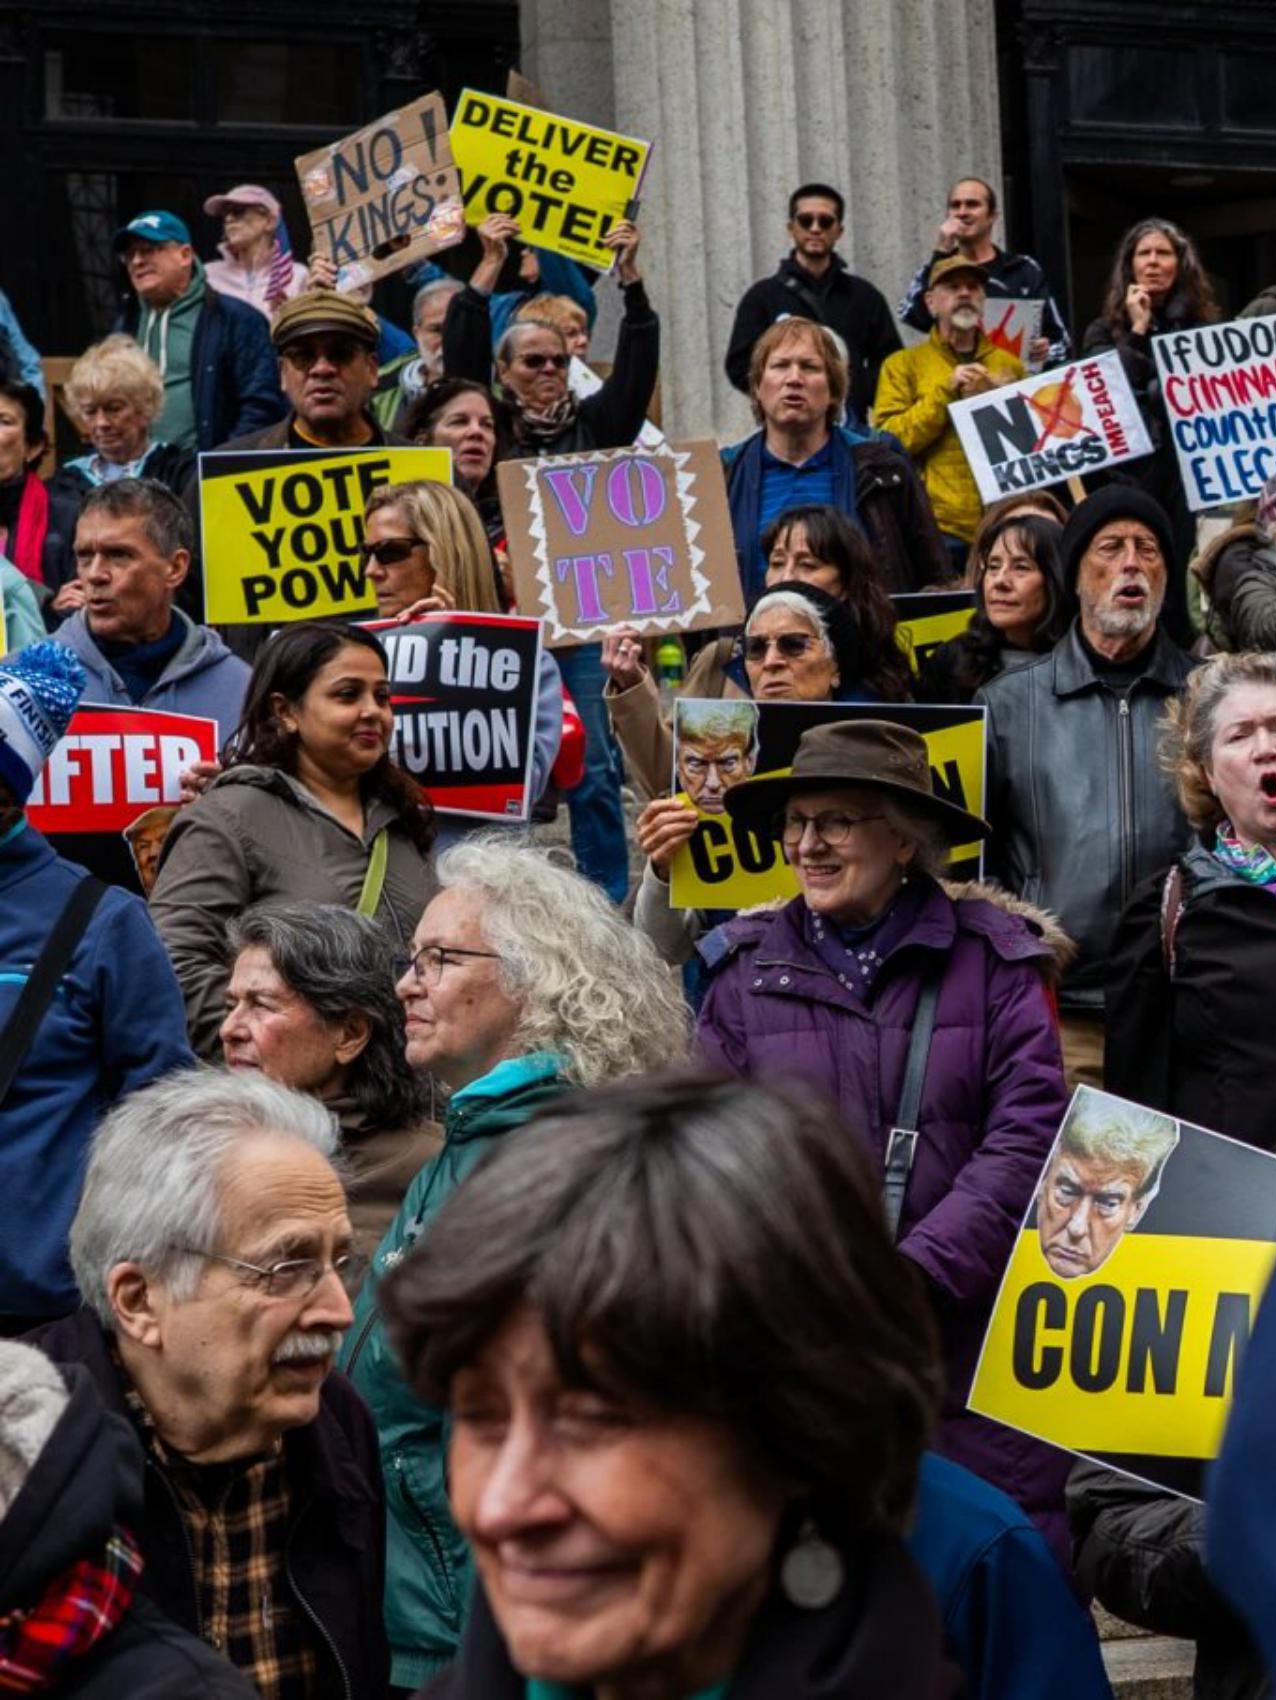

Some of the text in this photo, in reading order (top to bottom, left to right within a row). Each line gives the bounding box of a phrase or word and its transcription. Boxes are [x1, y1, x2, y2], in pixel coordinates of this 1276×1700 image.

[461, 99, 640, 178] DELIVER
[506, 148, 575, 193] the
[457, 167, 614, 250] VOTE!
[1080, 362, 1130, 457] IMPEACH
[992, 435, 1107, 494] KINGS
[251, 515, 364, 569] YOU
[241, 561, 367, 617] POW
[439, 636, 521, 691] the
[9, 688, 57, 750] FINISH
[389, 708, 520, 773] TUTION
[689, 819, 790, 884] CO
[1013, 1281, 1189, 1396] CON
